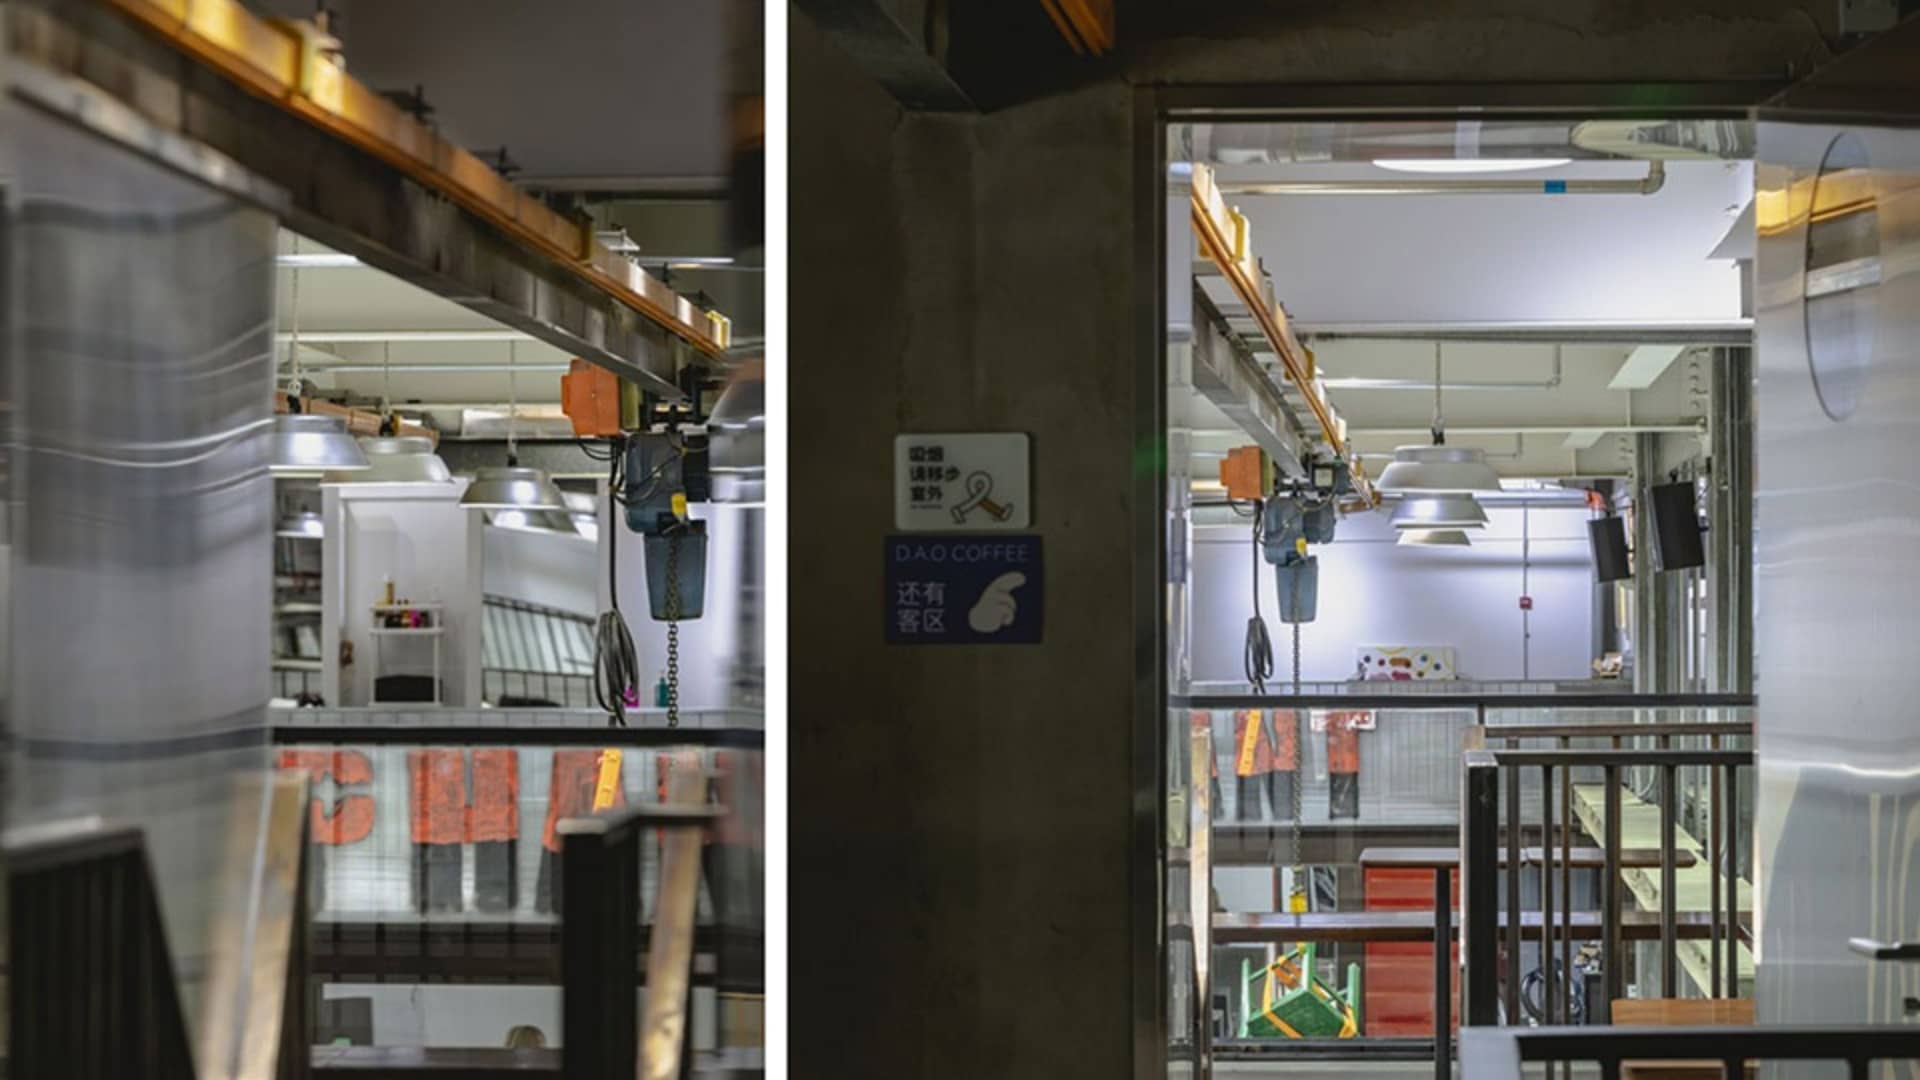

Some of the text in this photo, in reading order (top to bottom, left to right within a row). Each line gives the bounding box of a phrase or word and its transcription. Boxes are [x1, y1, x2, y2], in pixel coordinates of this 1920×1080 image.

[951, 544, 1029, 562] COFFEE
[896, 580, 946, 607] 还有
[896, 608, 946, 633] 客区
